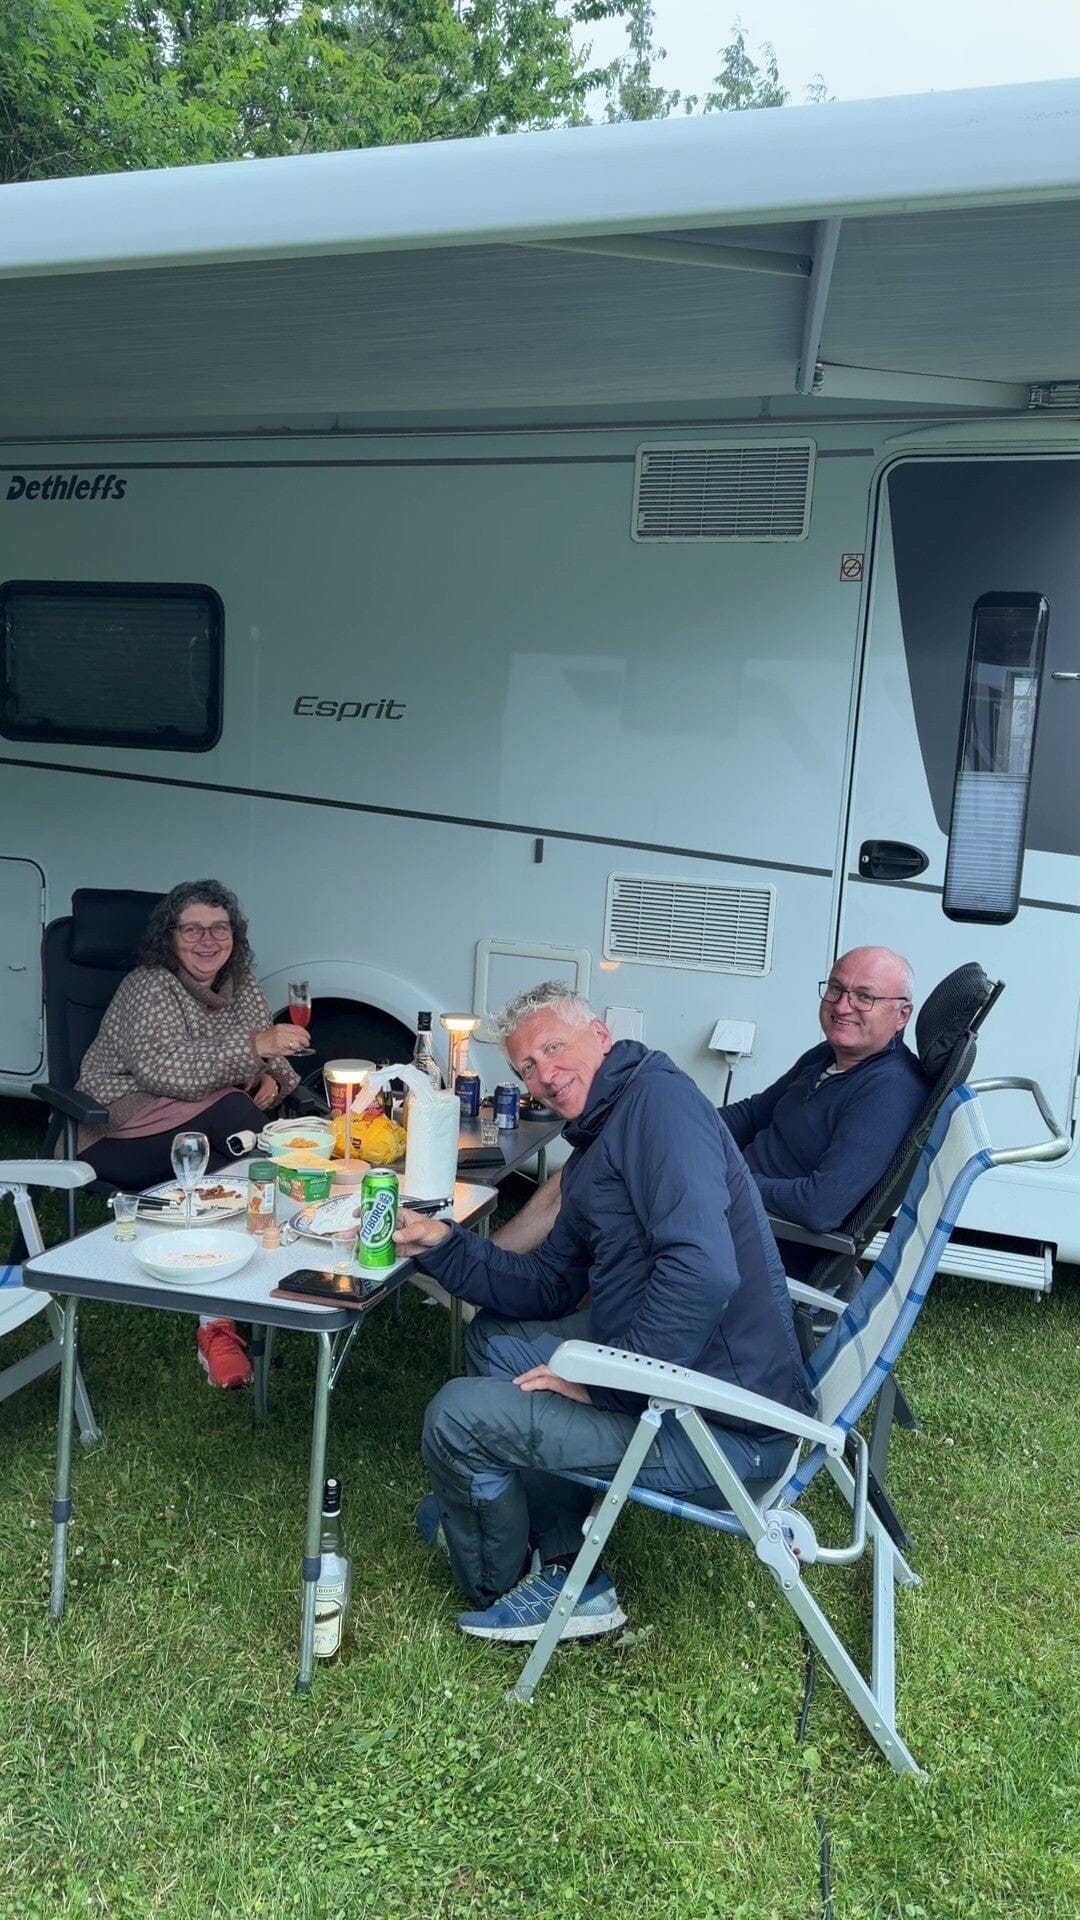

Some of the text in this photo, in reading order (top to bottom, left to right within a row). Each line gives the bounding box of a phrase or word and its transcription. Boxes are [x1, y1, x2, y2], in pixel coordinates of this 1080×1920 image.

[7, 474, 127, 500] Dethleffs
[293, 696, 406, 721] Esprit
[362, 1202, 387, 1240] TUBORG
